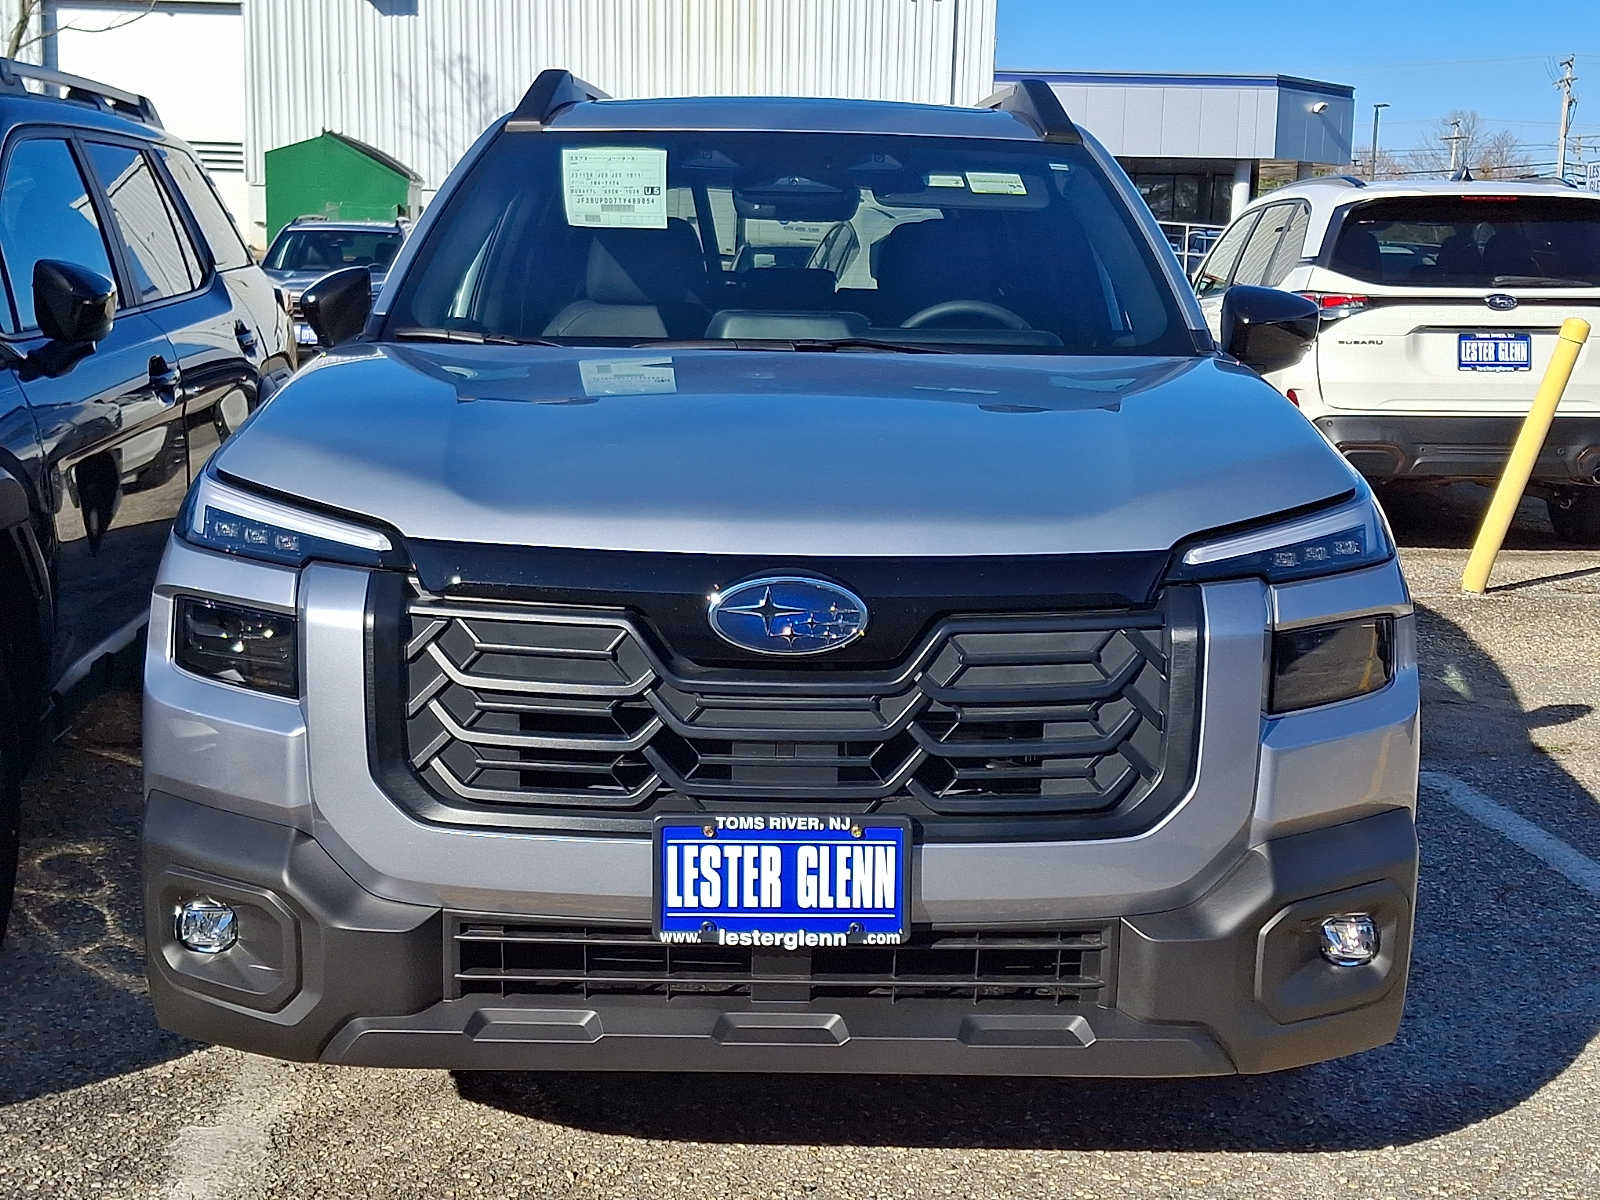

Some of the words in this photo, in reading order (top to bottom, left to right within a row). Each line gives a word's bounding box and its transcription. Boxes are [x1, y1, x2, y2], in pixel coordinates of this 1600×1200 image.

[1461, 342, 1495, 361] LESTER
[1498, 342, 1527, 361] GLENN
[715, 816, 765, 830] TOMS
[769, 816, 824, 832] RIVER,
[829, 817, 850, 831] NJ
[667, 845, 782, 908] LESTER
[797, 845, 896, 909] GLENN
[659, 931, 702, 944] www.
[718, 928, 848, 950] lesterglenn
[862, 932, 901, 945] .com
